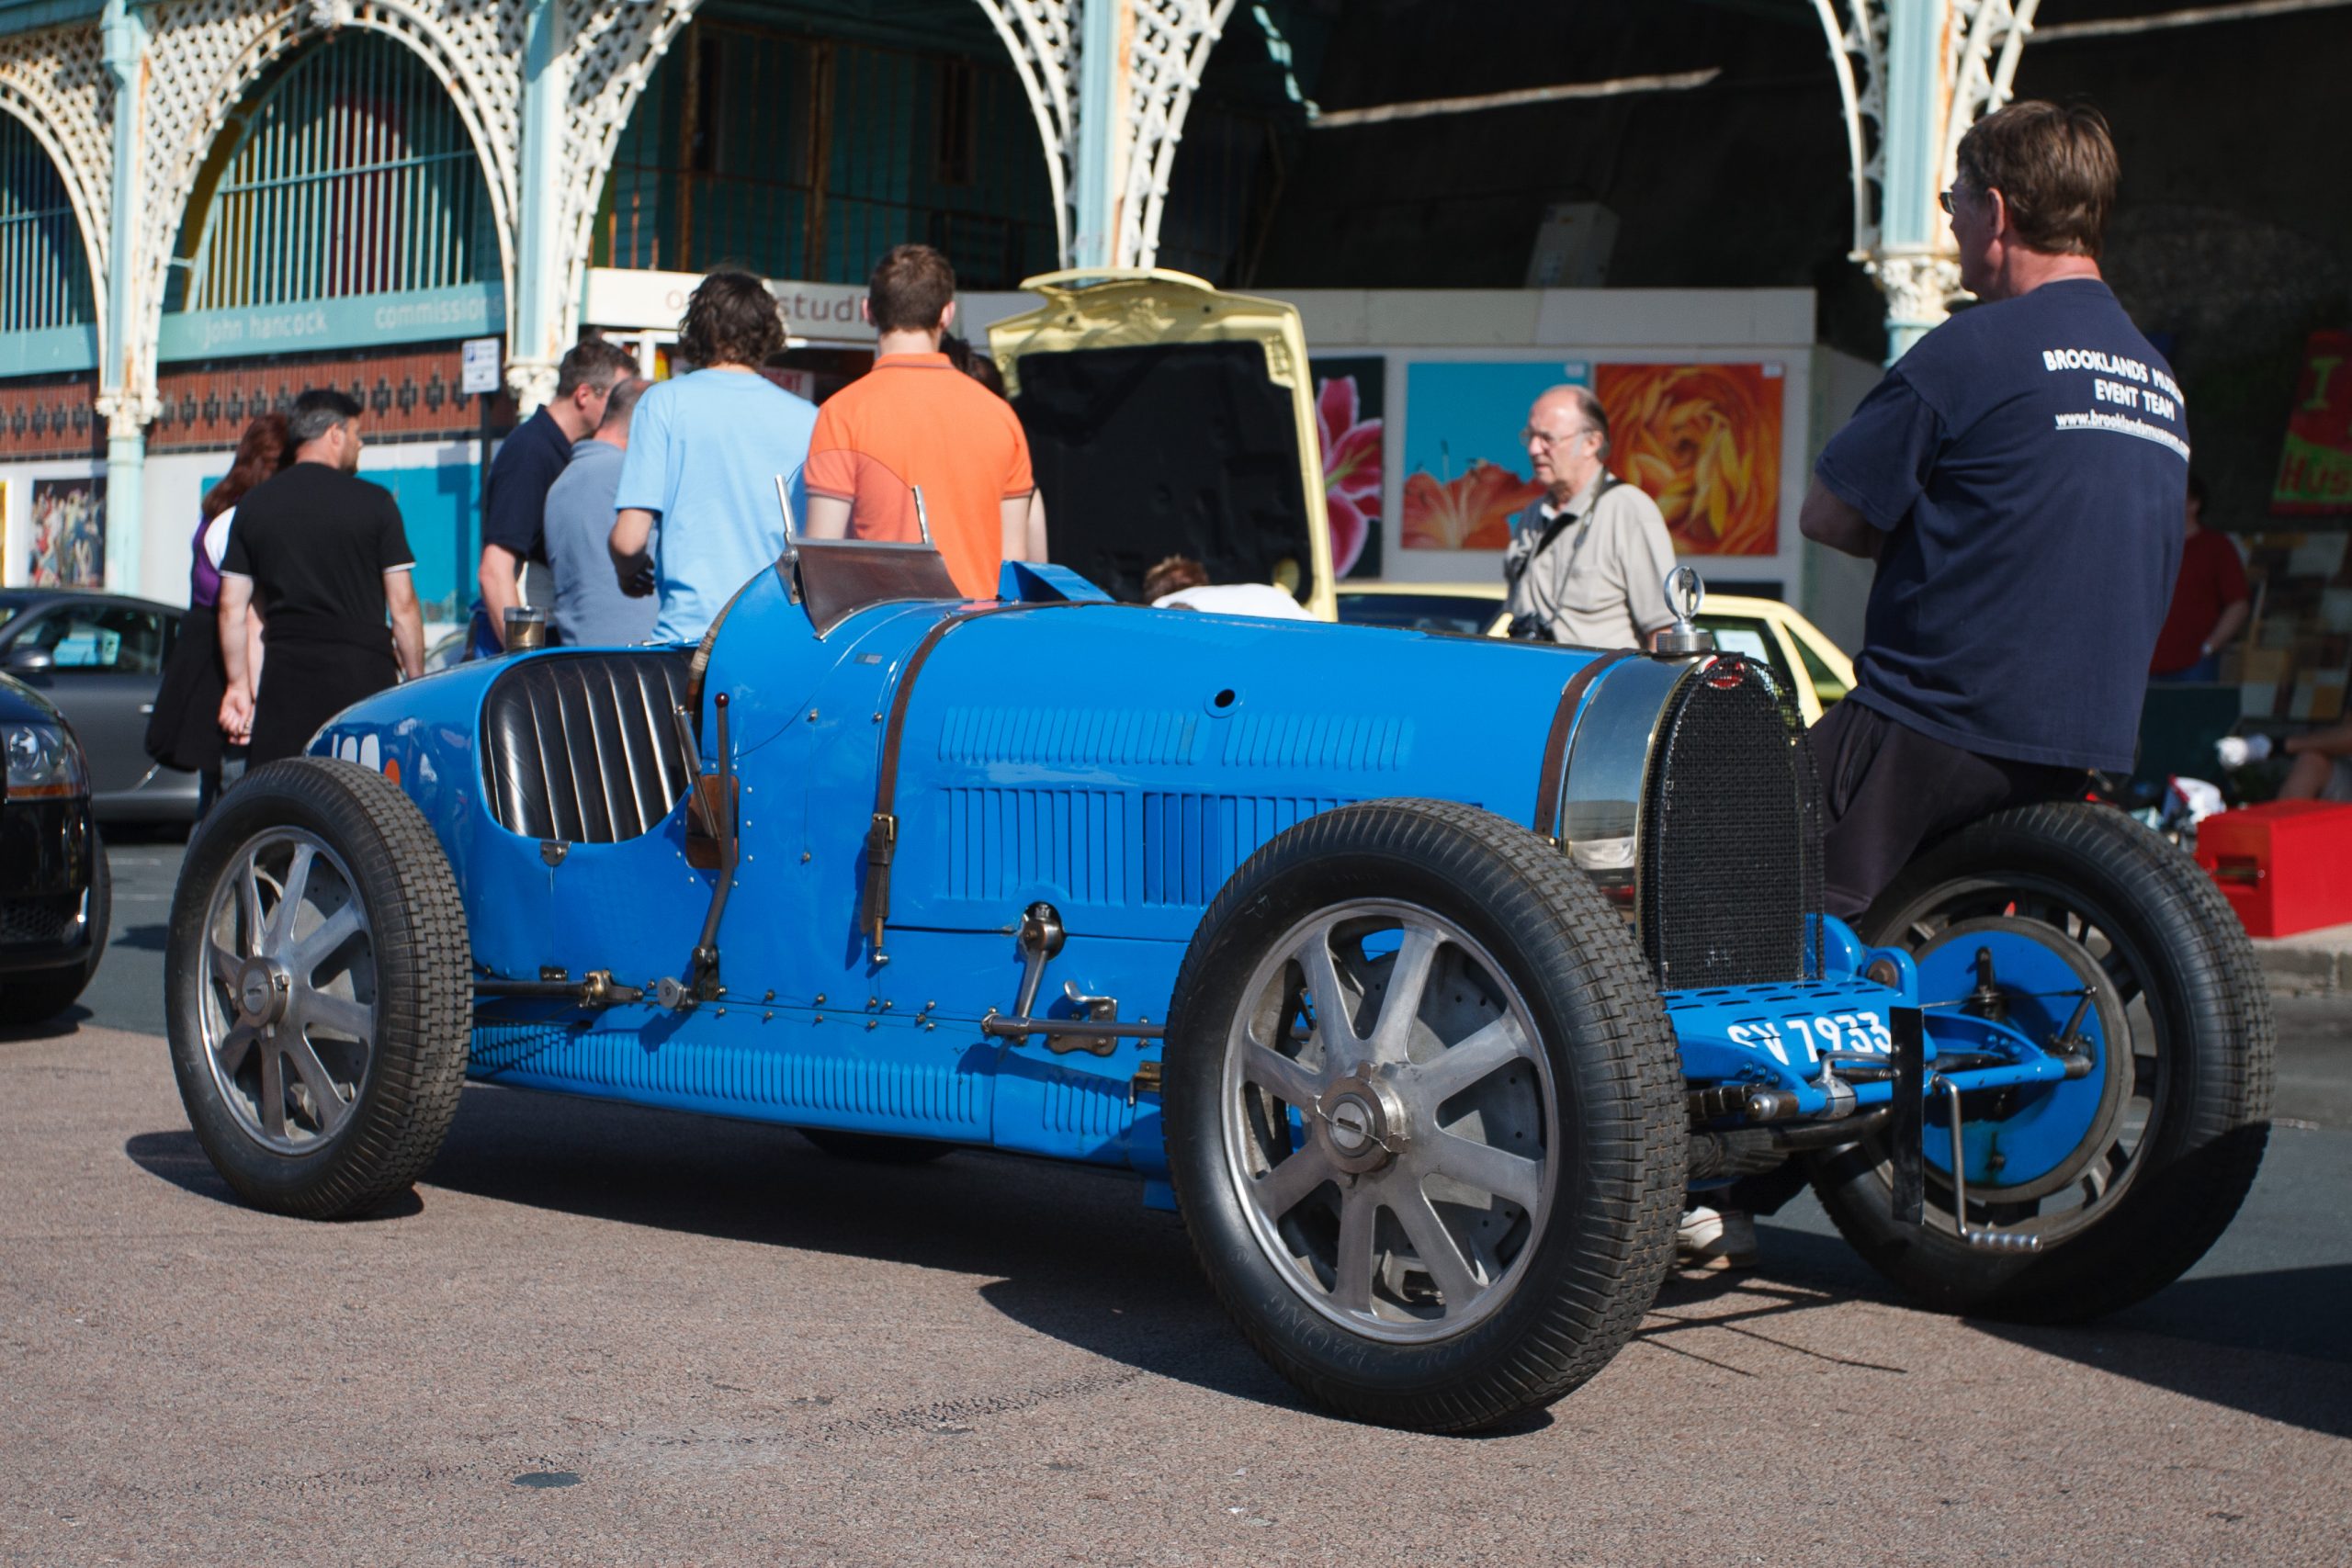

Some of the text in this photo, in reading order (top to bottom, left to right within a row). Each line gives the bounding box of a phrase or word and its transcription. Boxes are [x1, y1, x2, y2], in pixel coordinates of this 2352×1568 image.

[782, 293, 866, 323] studi
[2042, 348, 2148, 383] BROOKLANDS
[2094, 378, 2176, 422] EVENT TEAM
[1786, 1011, 1893, 1063] 7933
